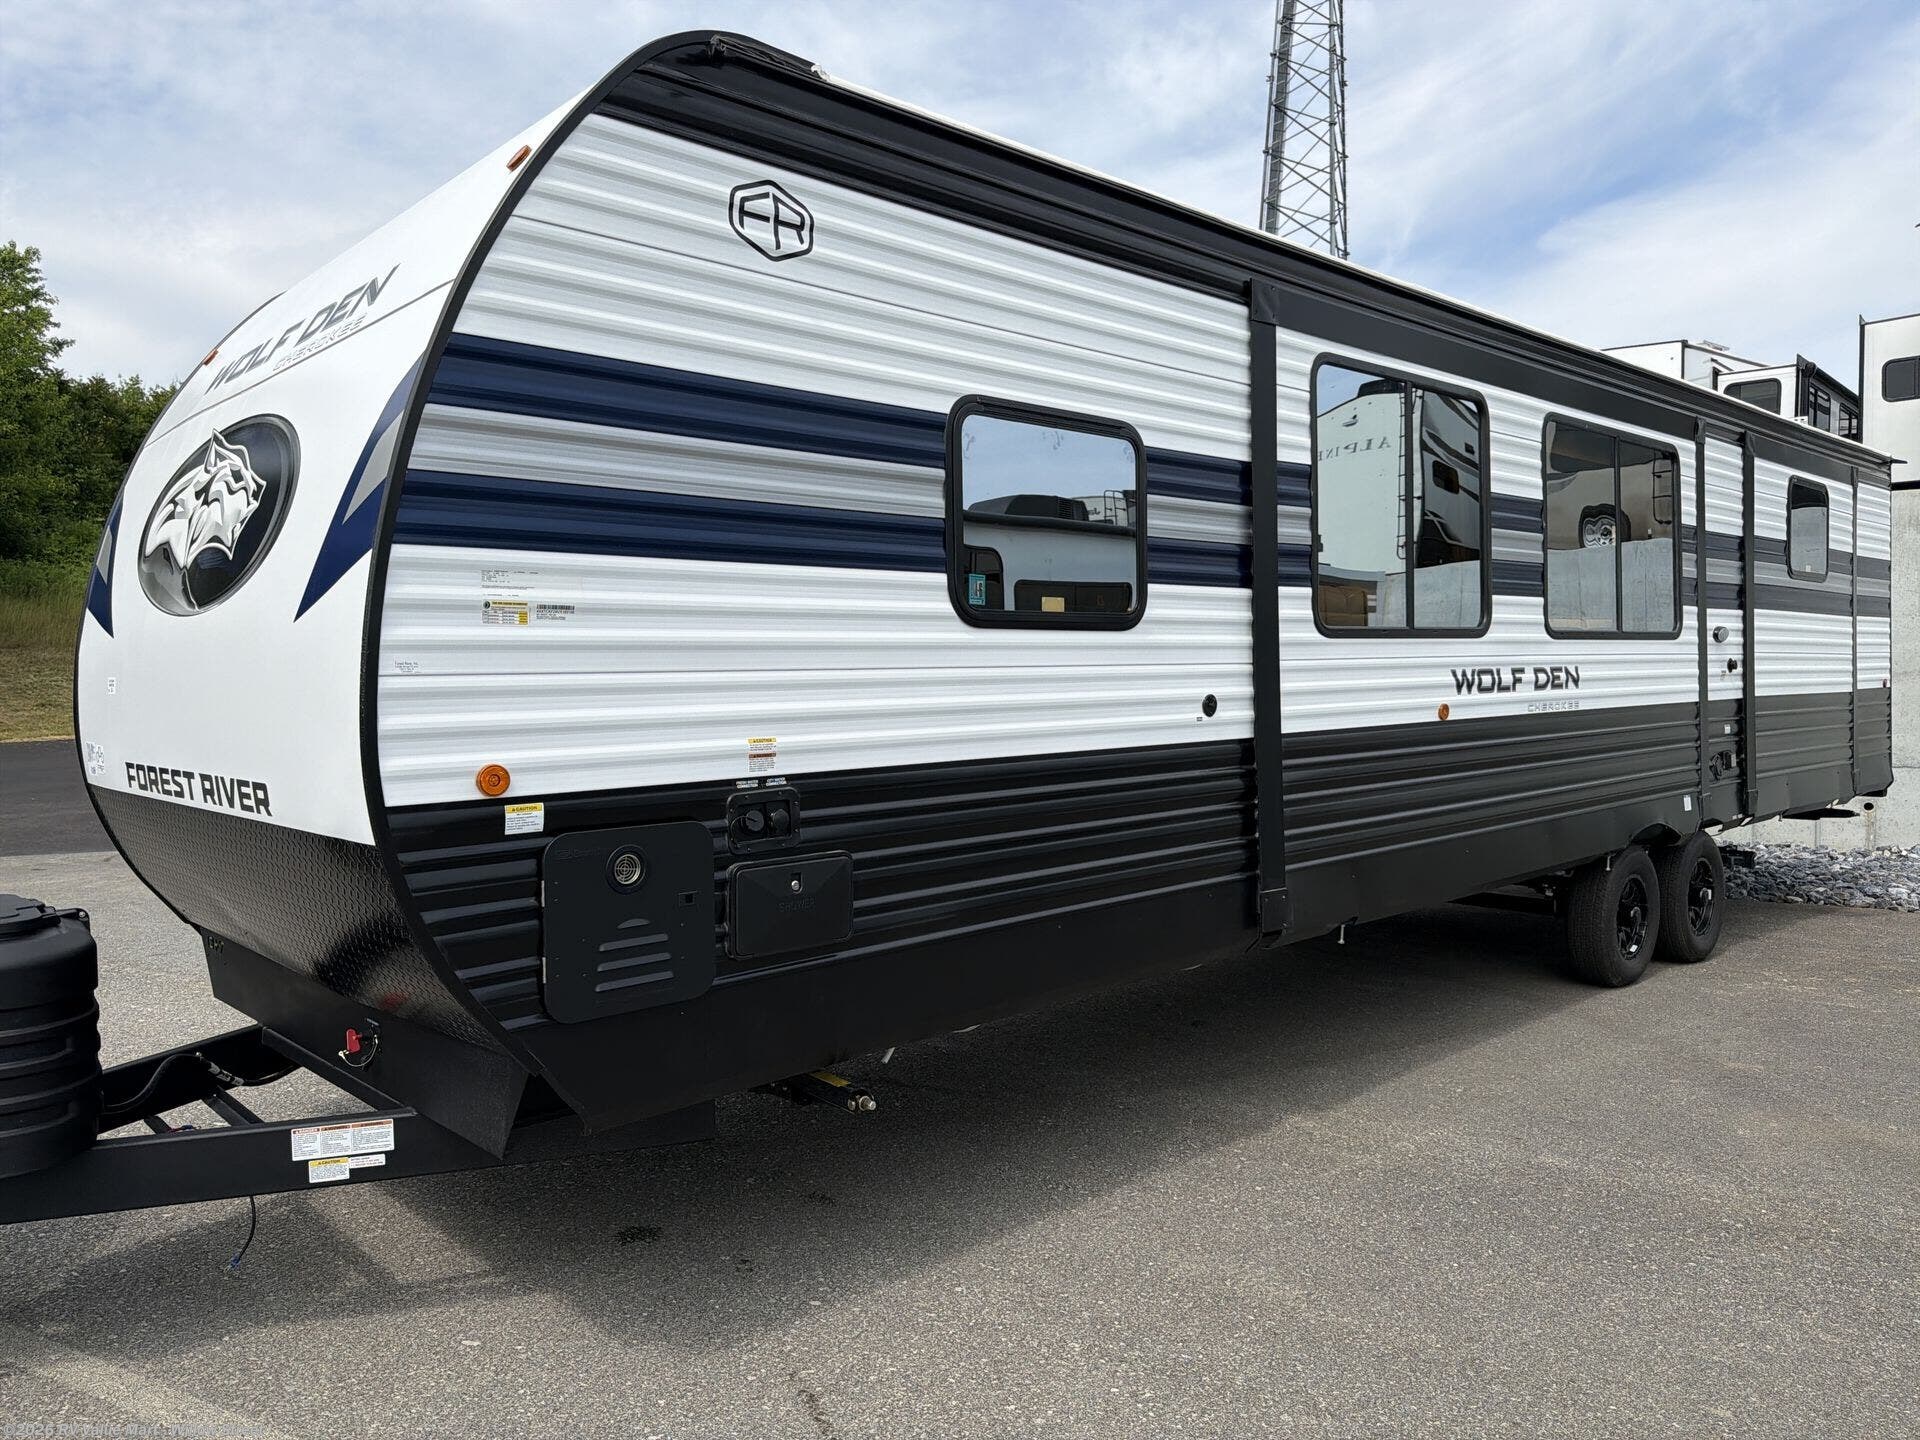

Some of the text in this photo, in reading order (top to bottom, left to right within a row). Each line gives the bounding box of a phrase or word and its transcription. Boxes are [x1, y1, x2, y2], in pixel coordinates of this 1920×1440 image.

[203, 262, 401, 396] WOLF DEN
[273, 312, 367, 371] CHEROKEE
[1450, 665, 1580, 695] WOLF DEN
[1527, 701, 1580, 712] CHEROKEE
[125, 761, 273, 817] FOREST RIVER
